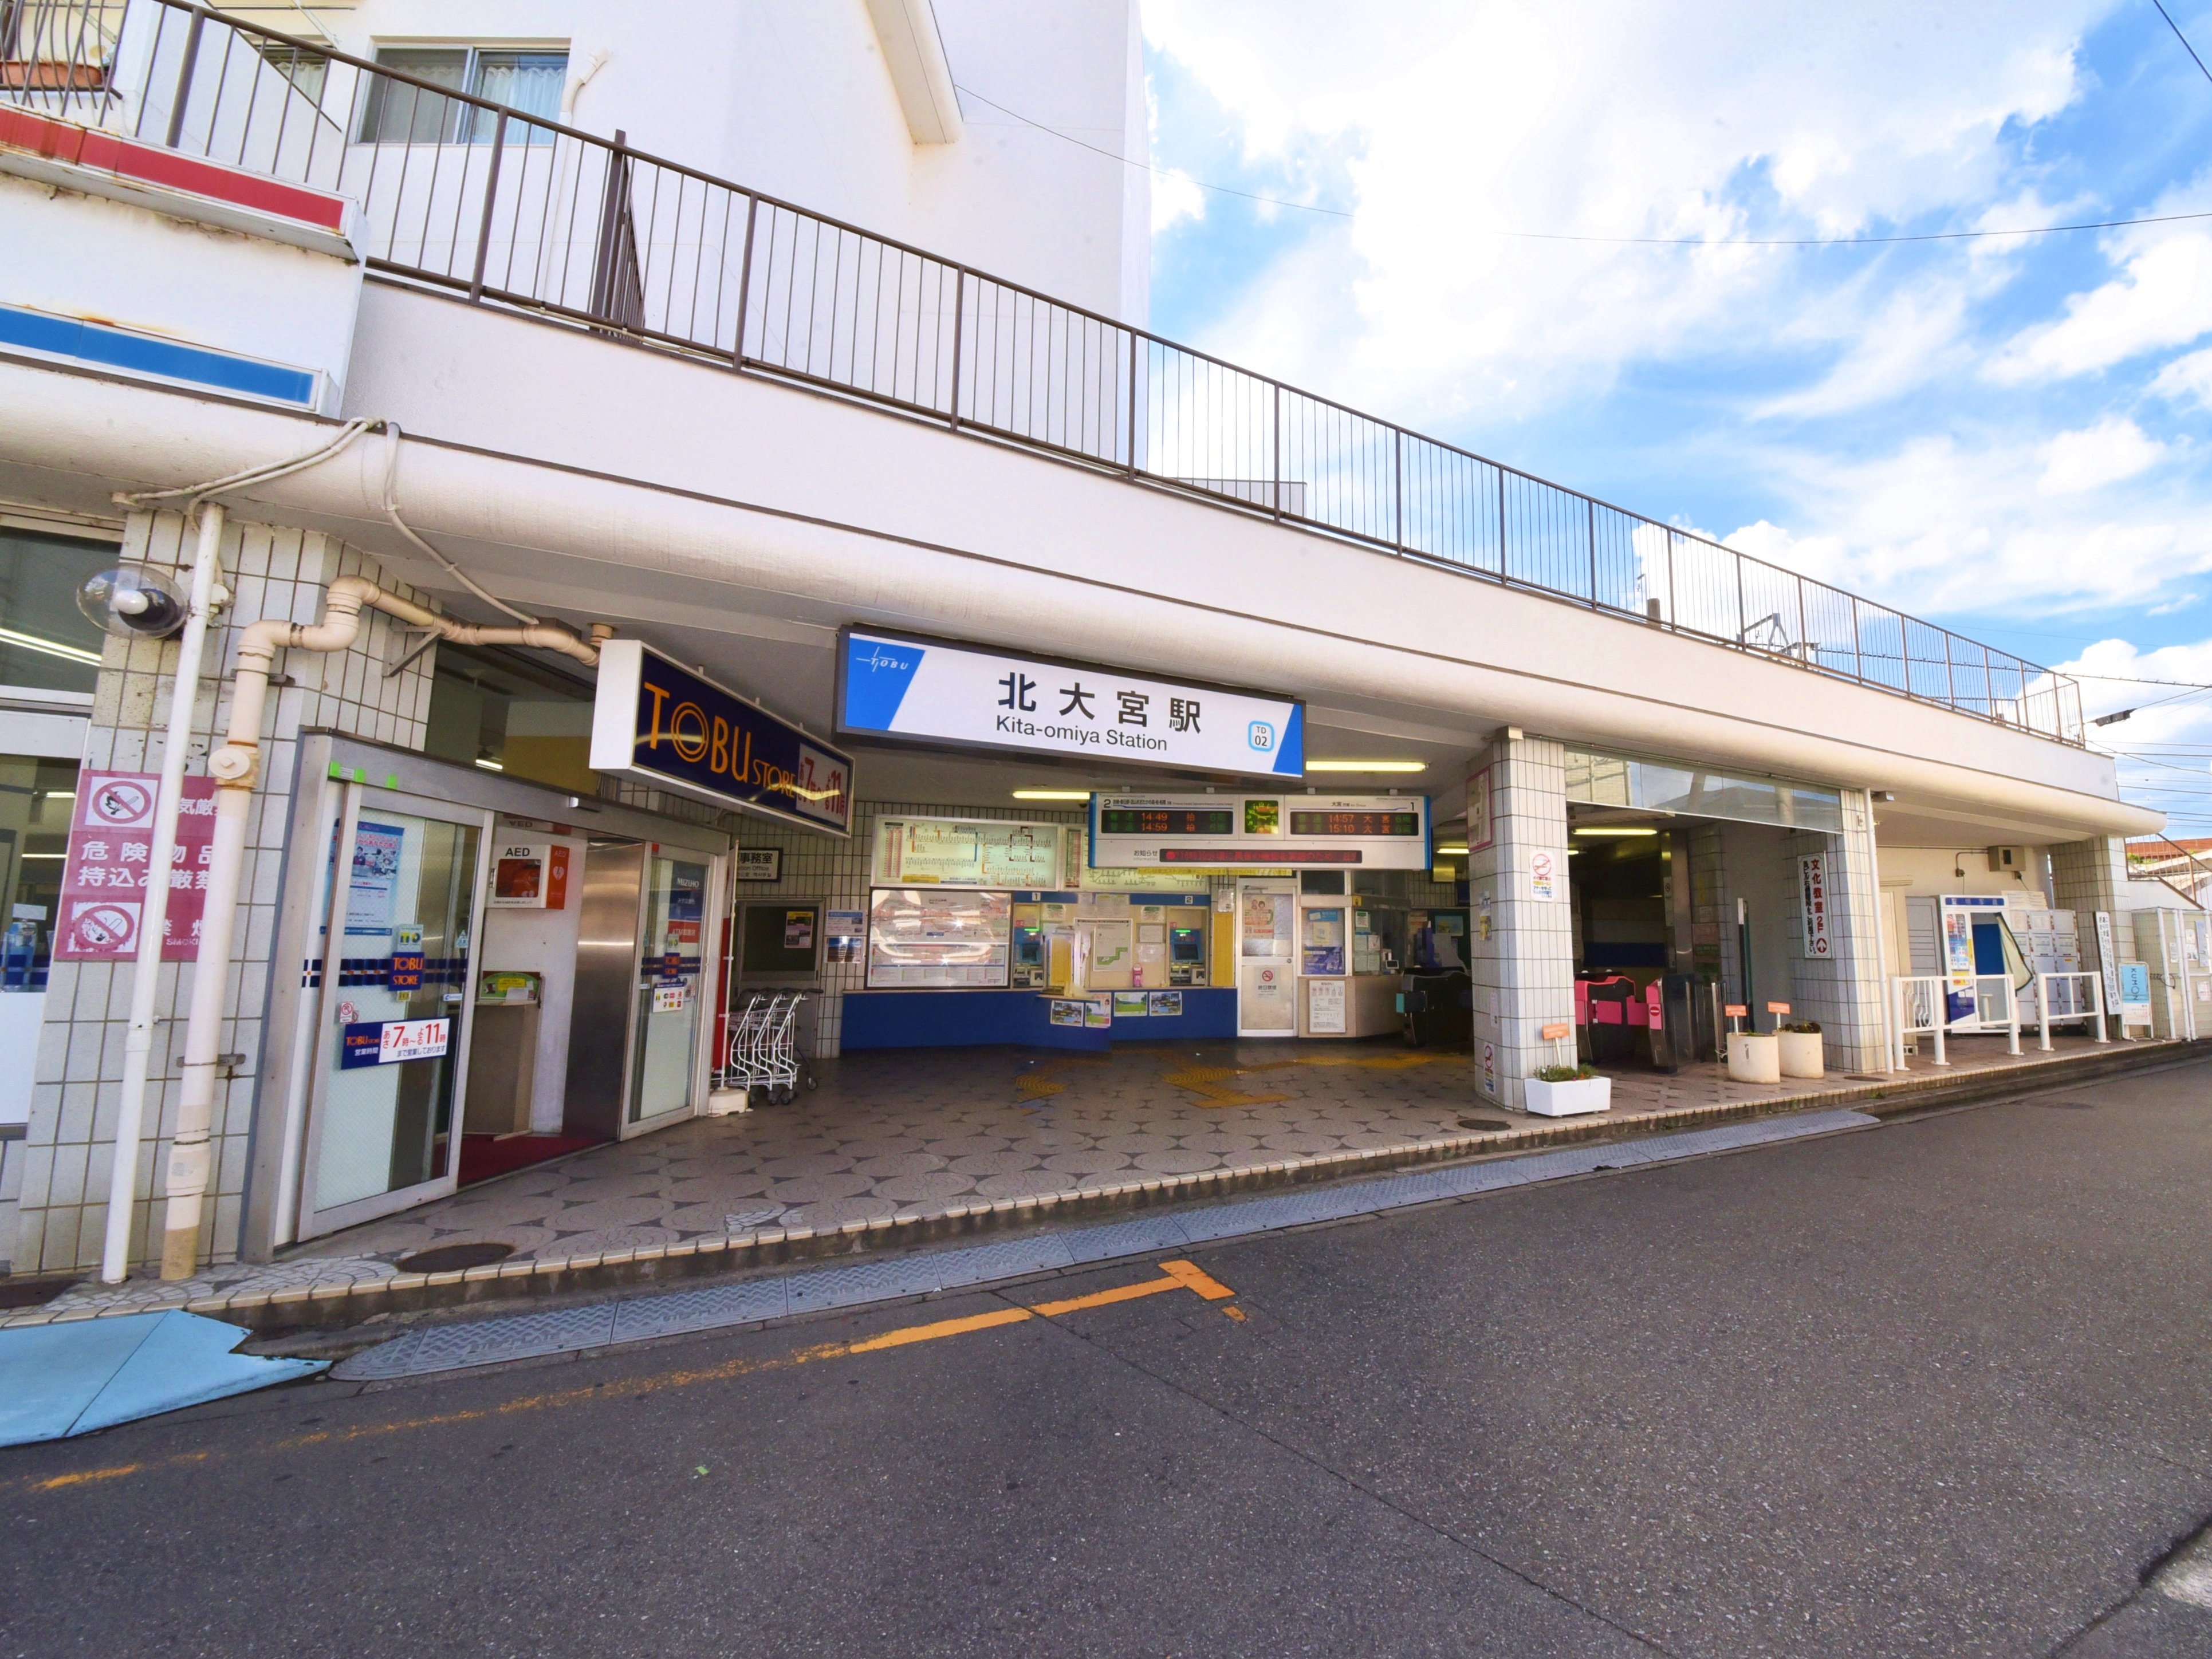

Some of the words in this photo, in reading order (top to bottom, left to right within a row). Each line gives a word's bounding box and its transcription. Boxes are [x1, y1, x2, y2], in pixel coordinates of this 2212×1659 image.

[998, 672, 1201, 734] 北大宮駅
[996, 715, 1100, 746] Kita-omiya
[1106, 729, 1167, 751] Station
[1256, 726, 1266, 734] TD
[644, 681, 752, 783] TOBU
[752, 758, 796, 798] STORE
[1255, 735, 1268, 747] 02
[1104, 799, 1111, 808] 2
[1410, 802, 1415, 811] 1
[1141, 813, 1168, 821] 14:49
[1328, 814, 1354, 823] 14:57
[1363, 814, 1390, 823] 大宮
[1141, 822, 1168, 831] 14:59
[1328, 824, 1354, 833] 15:10
[1363, 824, 1390, 833] 大宮
[505, 848, 530, 857] AED
[554, 850, 566, 858] AED
[738, 852, 773, 864] 事務室
[676, 877, 699, 889] MIZUHO
[1811, 859, 1824, 933] 文化教室2F
[166, 937, 199, 945] SMOKI
[393, 957, 423, 971] TOBU
[393, 975, 419, 986] STORE
[2131, 968, 2140, 1001] KUMON
[346, 1035, 368, 1046] TOBU
[355, 1047, 379, 1057] 営業時間
[397, 1045, 446, 1058] まで営業しております
